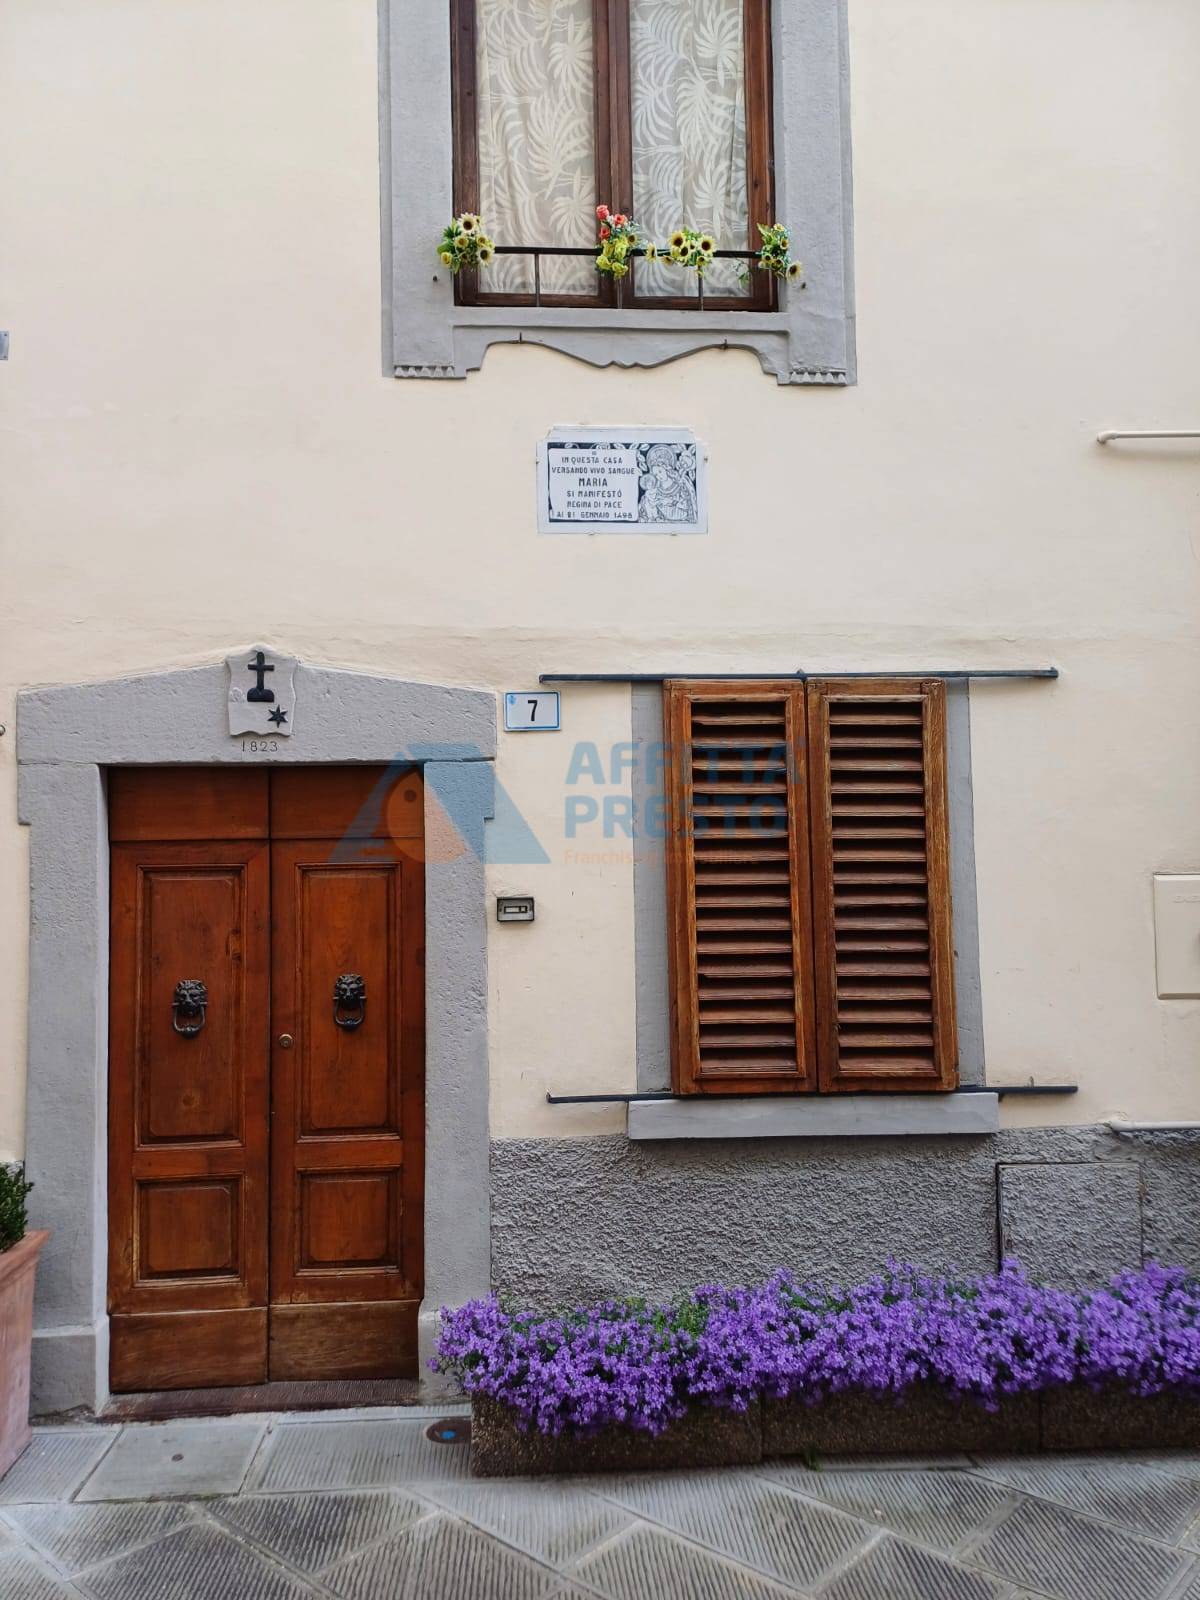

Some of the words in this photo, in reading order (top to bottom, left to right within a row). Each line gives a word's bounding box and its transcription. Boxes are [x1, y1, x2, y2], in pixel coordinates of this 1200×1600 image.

[571, 457, 599, 465] QUESTA
[608, 467, 635, 475] SANGUE
[578, 477, 608, 487] MARIA
[527, 699, 538, 722] 7
[242, 739, 278, 752] 1823
